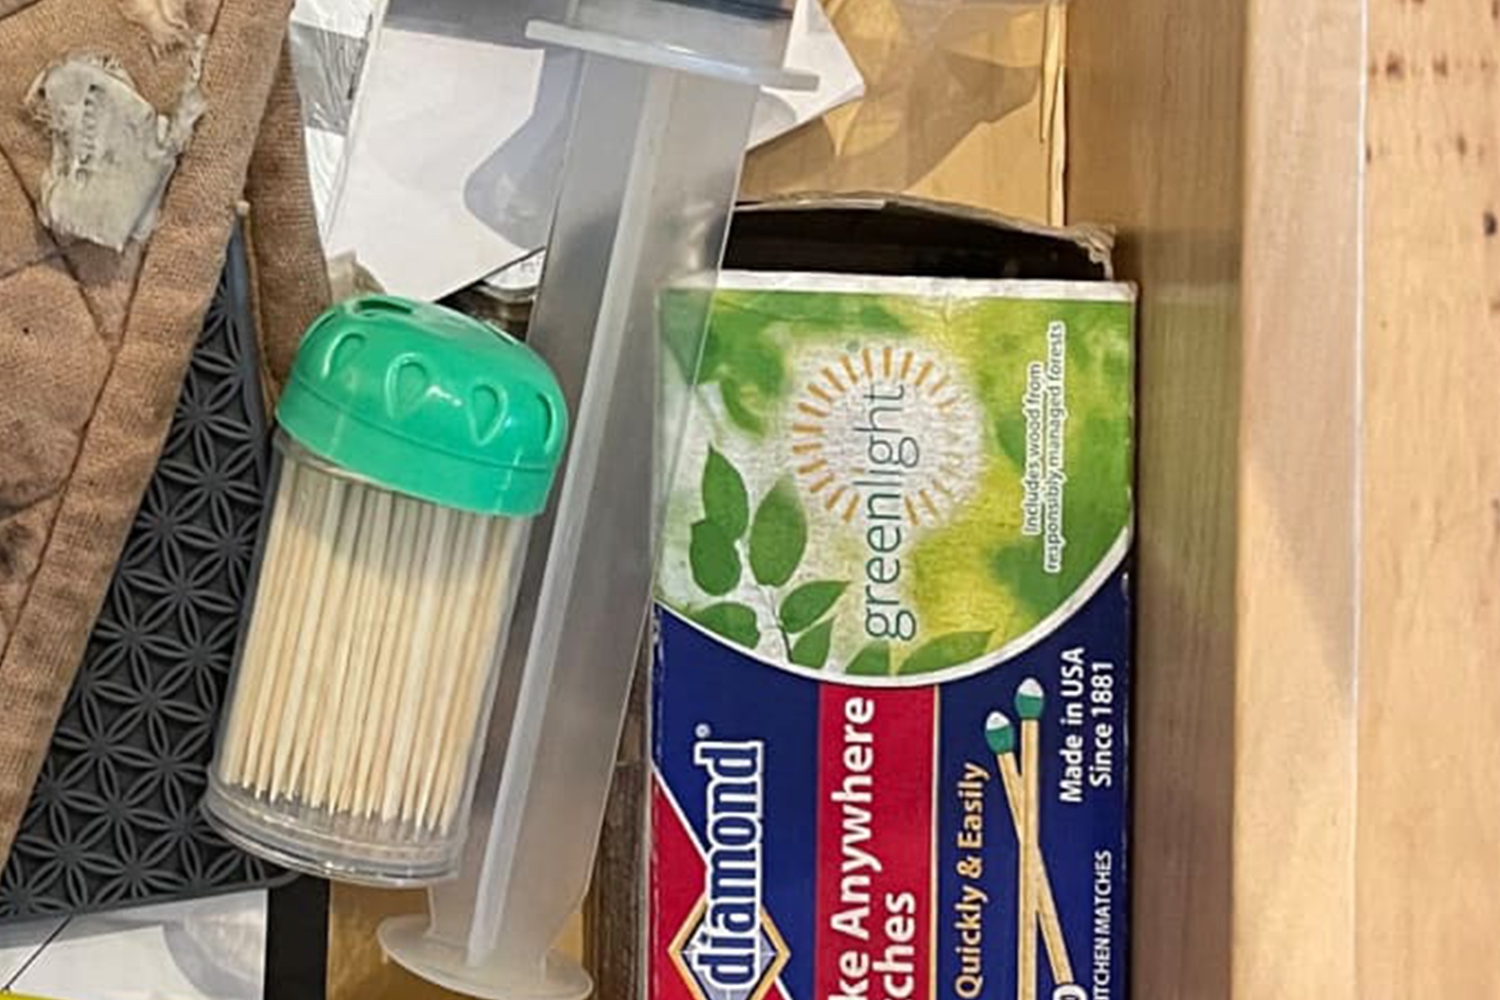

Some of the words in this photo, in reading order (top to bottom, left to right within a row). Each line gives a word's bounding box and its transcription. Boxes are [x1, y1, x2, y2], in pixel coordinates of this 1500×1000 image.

[1025, 363, 1042, 405] from
[1049, 322, 1064, 381] forests
[1024, 407, 1041, 459] wood
[1048, 386, 1067, 467] managed
[852, 383, 920, 641] greenlight
[1024, 460, 1041, 533] Includes
[1047, 472, 1065, 570] responsibly
[1061, 647, 1084, 697] USA
[1090, 663, 1113, 717] 1881
[1060, 703, 1083, 725] in
[1059, 734, 1083, 802] Made
[1089, 723, 1113, 788] Since
[831, 697, 882, 940] Anywhere
[957, 762, 990, 848] Easily
[692, 740, 764, 988] diamond
[956, 855, 982, 879] &
[1094, 850, 1112, 935] MATCHES
[828, 951, 869, 1000] ke
[873, 892, 916, 1000] ches
[954, 884, 989, 999] Quickly
